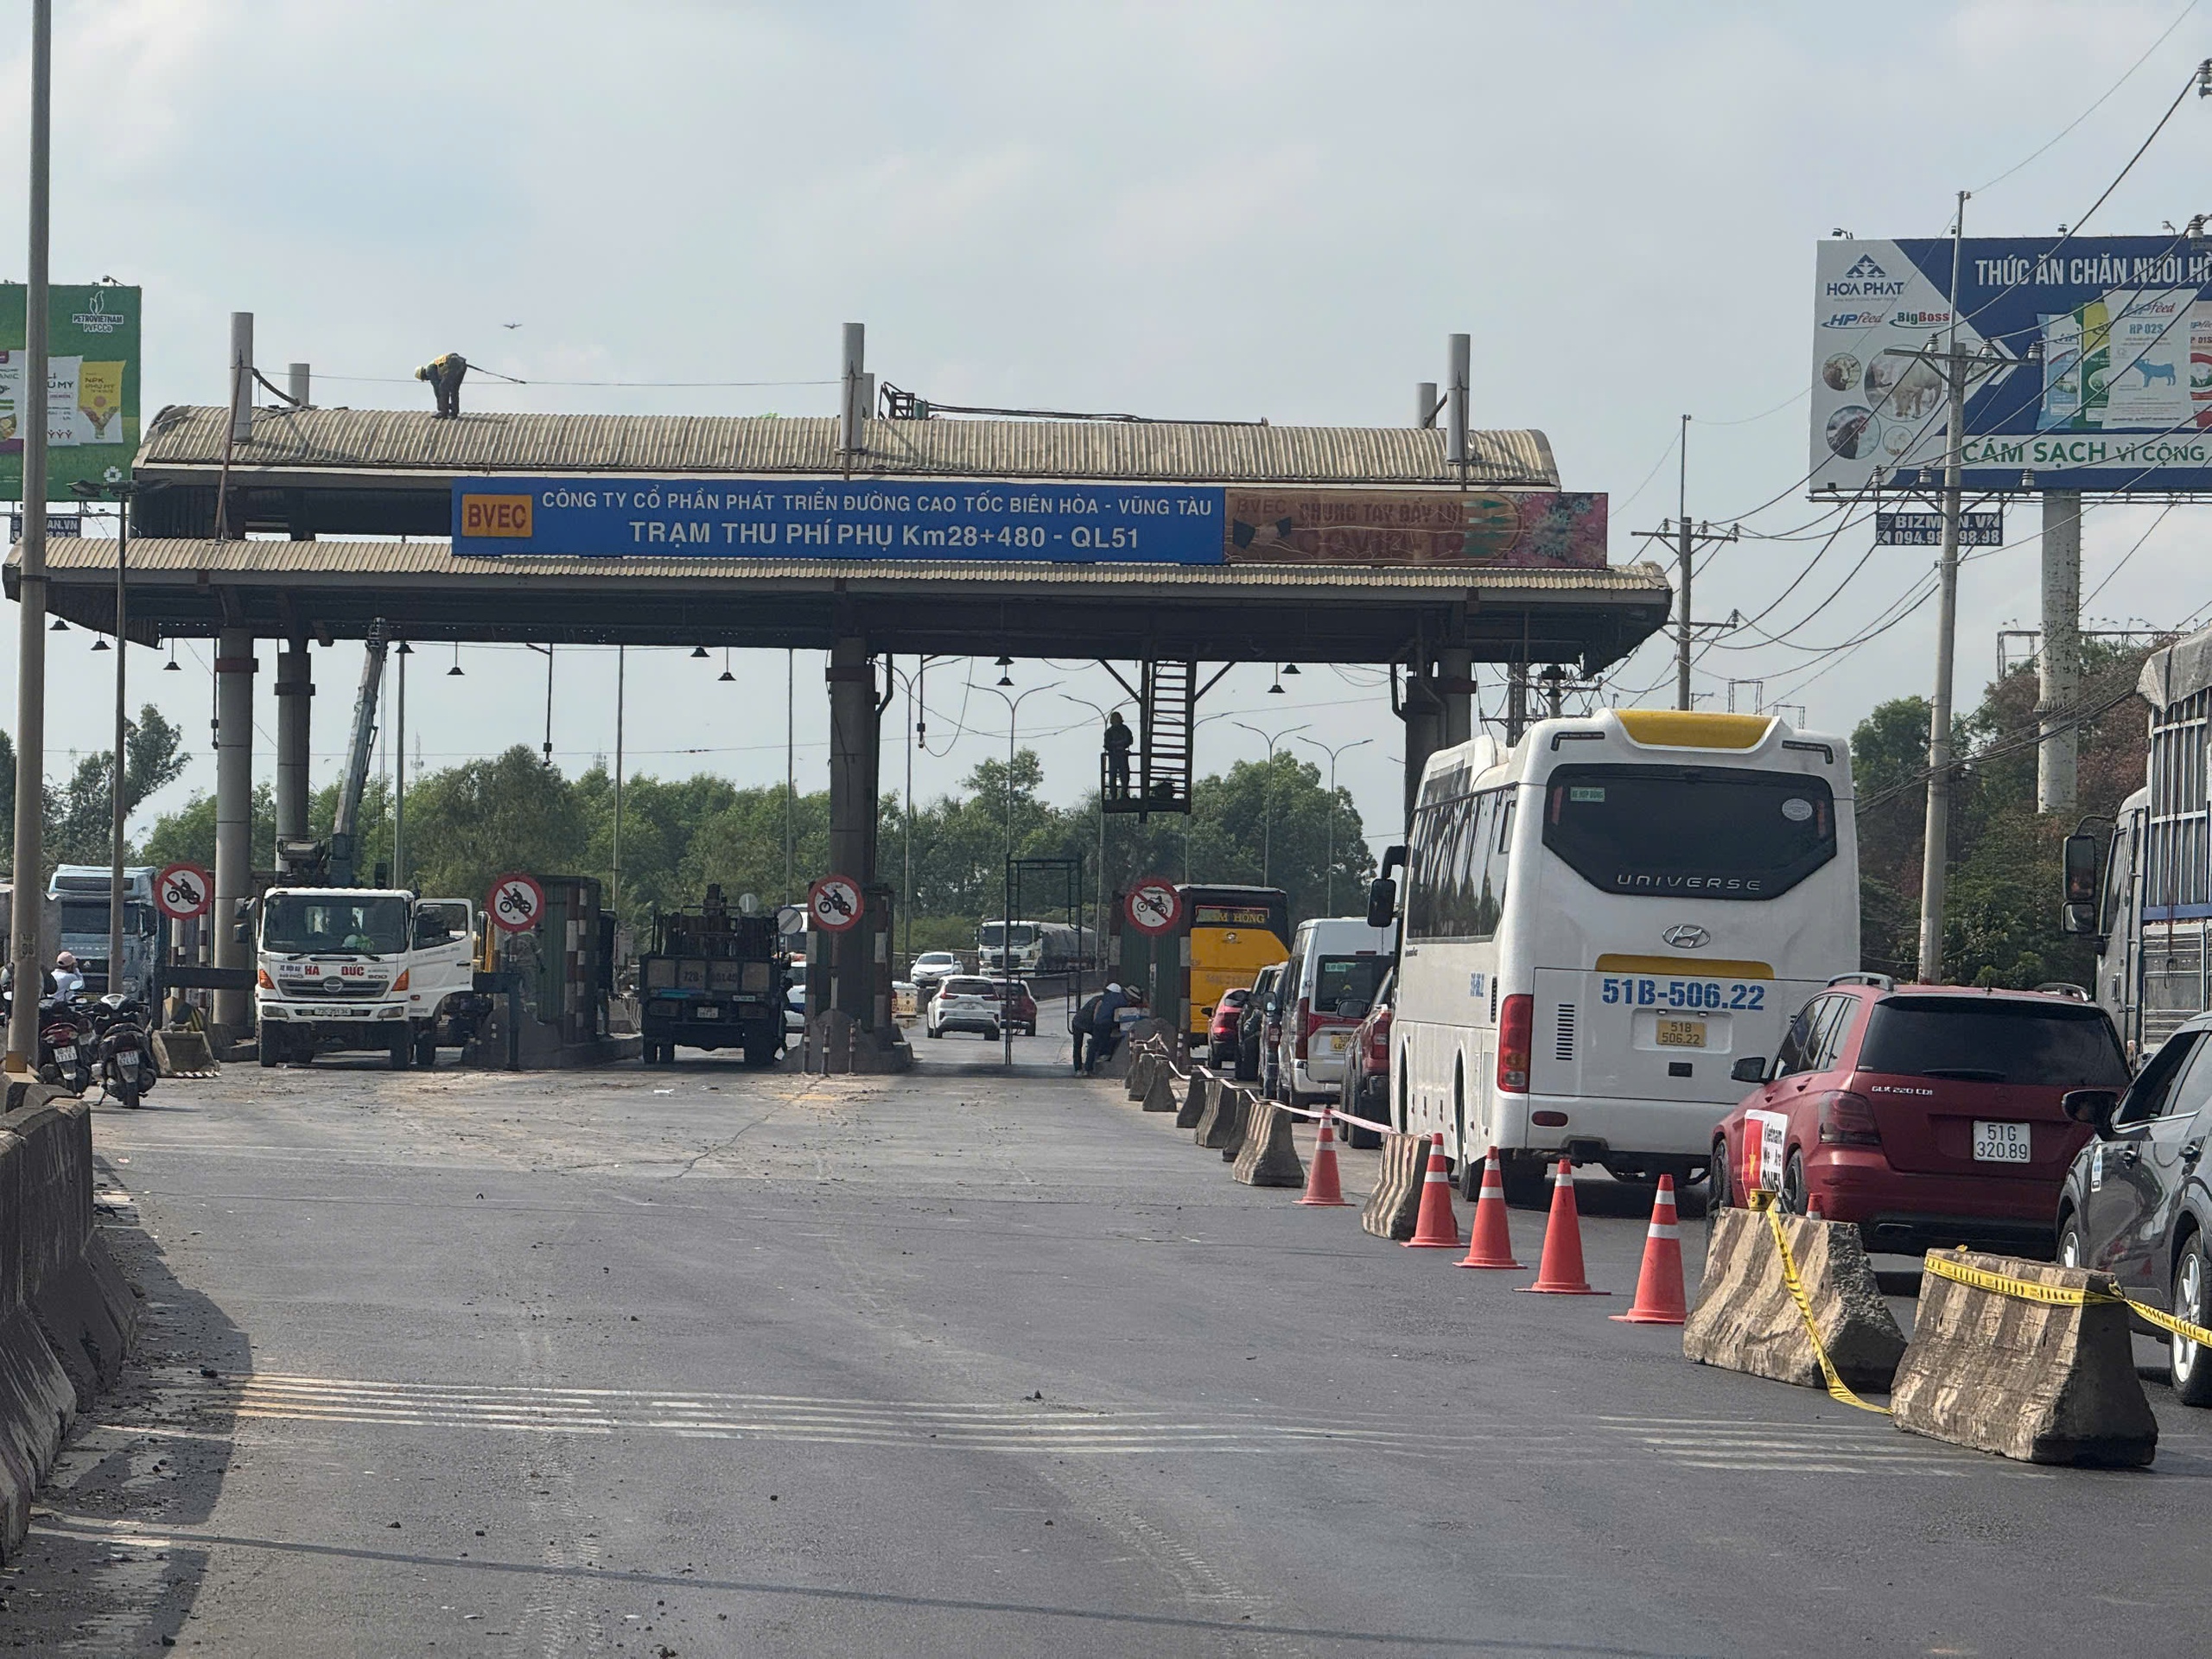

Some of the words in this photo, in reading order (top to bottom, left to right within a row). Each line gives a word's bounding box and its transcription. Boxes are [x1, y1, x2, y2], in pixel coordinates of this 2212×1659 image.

[1975, 254, 2030, 286] THỨC
[2035, 253, 2064, 285] ĂN
[2070, 253, 2126, 285] CHĂN
[2133, 253, 2182, 283] NUÔI
[73, 315, 123, 323] PETROVIETNAM
[1961, 437, 2024, 462] CÁM
[2033, 441, 2107, 468] SẠCH
[2142, 442, 2204, 467] CỘNG
[542, 489, 596, 509] CÔNG
[602, 492, 627, 509] TY
[633, 484, 660, 510] CỔ
[667, 486, 719, 510] PHẦN
[727, 489, 775, 511] PHÁT
[783, 486, 838, 512] TRIỂN
[843, 491, 911, 512] ĐƯỜNG
[918, 496, 957, 512] CAO
[964, 490, 1004, 512] TỐC
[1009, 493, 1053, 513] BIÊN
[1059, 494, 1098, 514] HÒA
[1119, 493, 1169, 515] VŨNG
[1178, 495, 1211, 516] TÀU
[467, 503, 526, 529] BVEC
[1895, 515, 2000, 528] BIZMN.VN
[629, 521, 710, 548] TRẠM
[721, 523, 777, 543] THU
[786, 518, 833, 544] PHÍ
[836, 524, 893, 551] PHỤ
[903, 524, 1046, 547] Km28+480
[1071, 527, 1138, 549] QL51
[1617, 874, 1762, 891] UNIVERSE
[1602, 977, 1764, 1011] 51B-506.22
[1671, 1021, 1692, 1033] 51B
[1662, 1033, 1700, 1045] 506.22
[1987, 1124, 2017, 1141] 51G
[1976, 1141, 2028, 1160] 320.89
